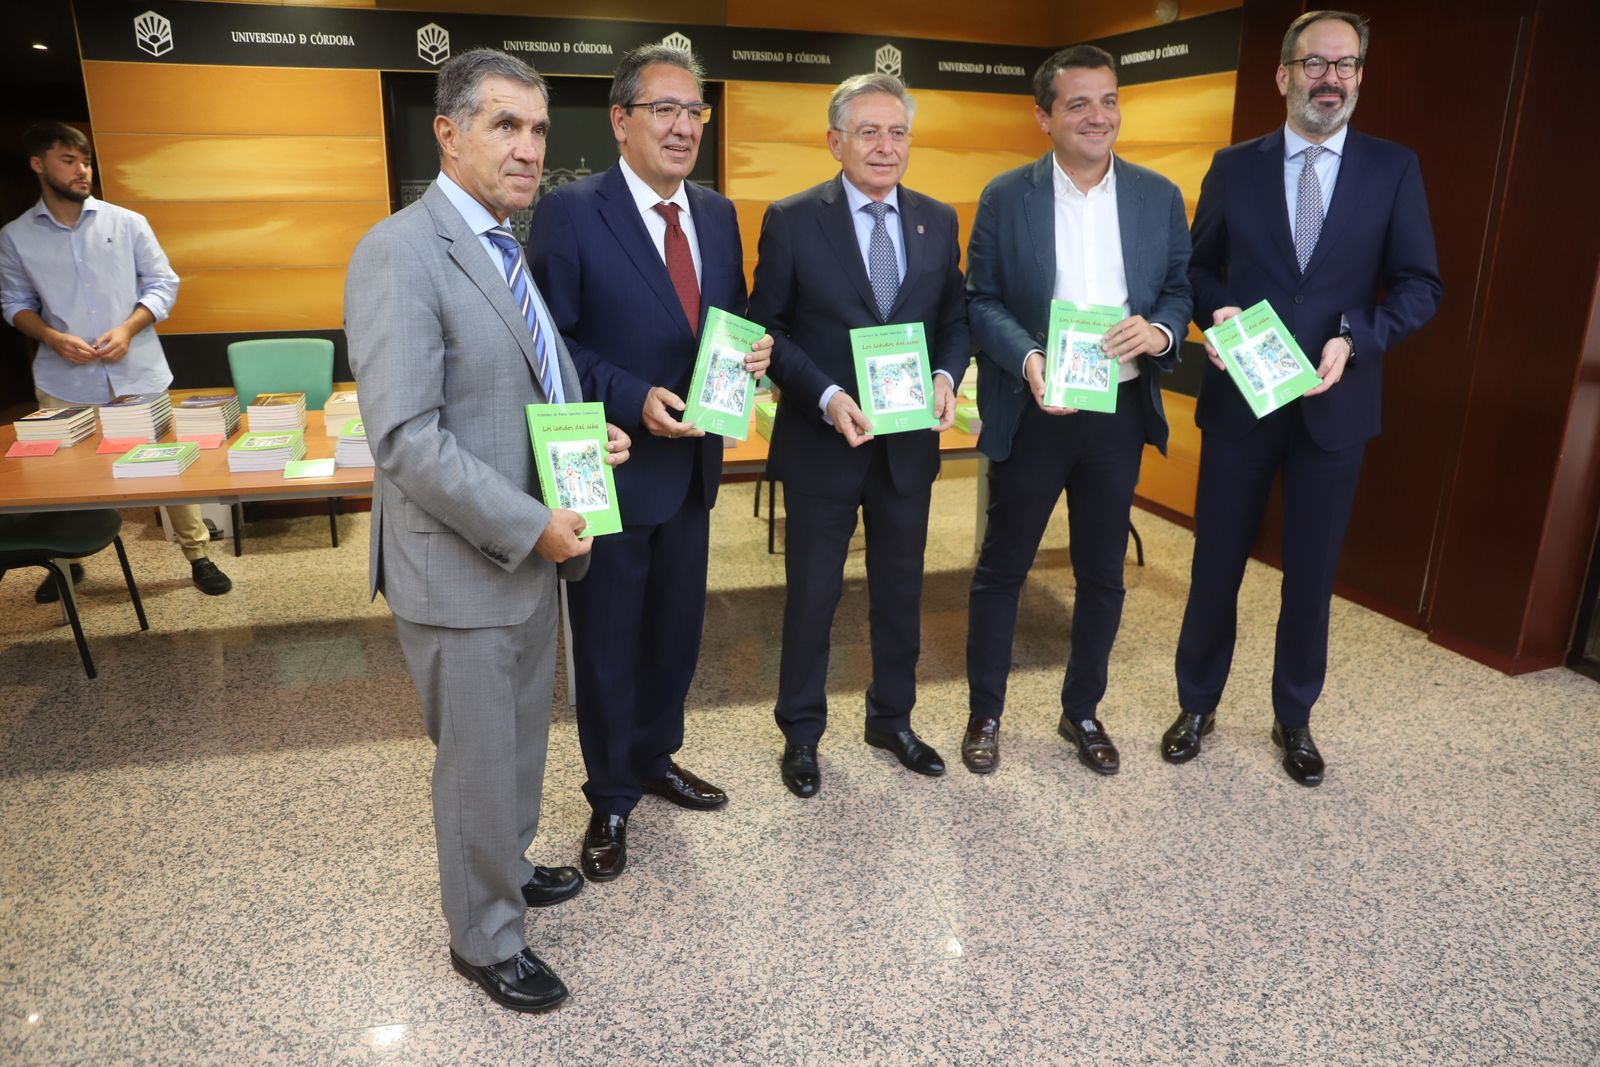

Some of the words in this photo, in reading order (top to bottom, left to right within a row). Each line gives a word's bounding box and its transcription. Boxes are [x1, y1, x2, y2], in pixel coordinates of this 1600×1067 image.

[231, 31, 295, 44] UNIVERSIDAD
[310, 31, 355, 46] CÓRDOBA
[503, 40, 561, 52] UNIVERSIDAD
[573, 40, 613, 55] CÓRDOBA
[732, 49, 784, 62] UNIVERSIDAD
[795, 51, 831, 64] CÓRDOBA
[938, 61, 984, 74] UNIVERSIDAD
